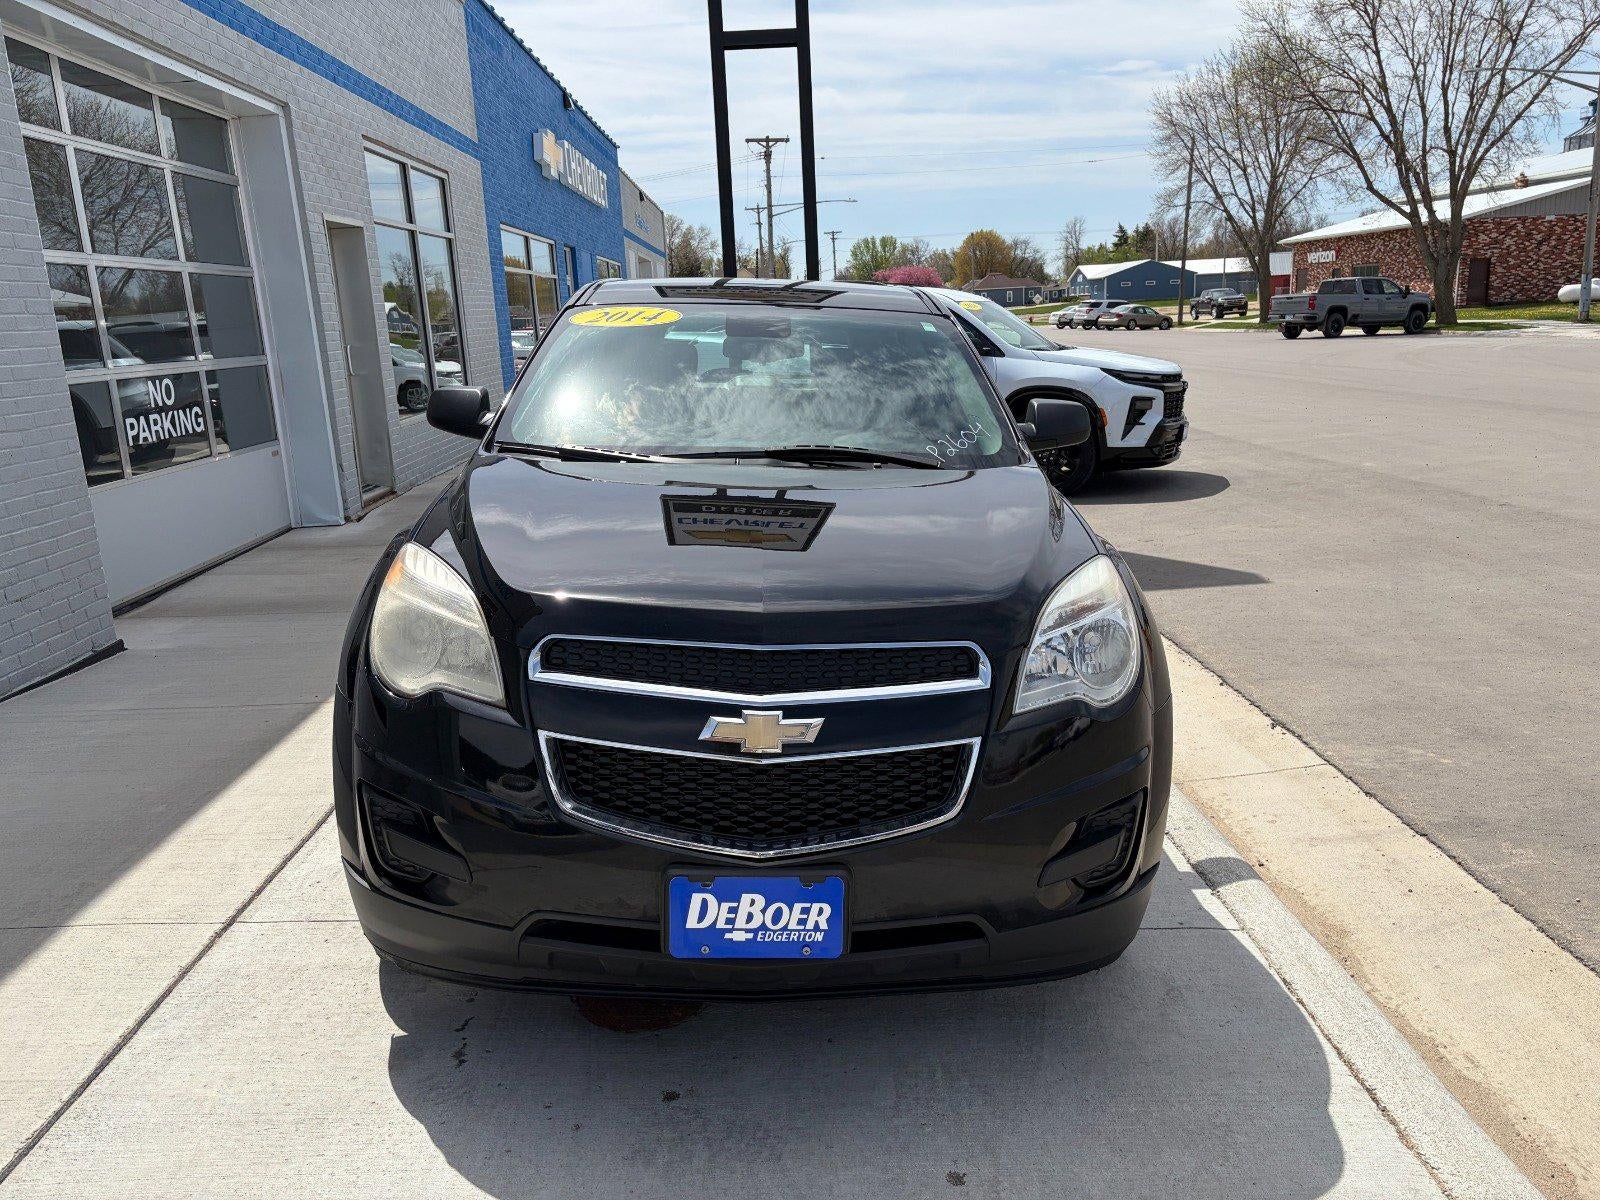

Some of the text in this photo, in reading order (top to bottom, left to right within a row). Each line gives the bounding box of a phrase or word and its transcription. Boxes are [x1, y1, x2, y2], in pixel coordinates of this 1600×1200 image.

[1307, 250, 1336, 263] verizon
[584, 309, 669, 323] 2014
[147, 378, 175, 407] NO
[125, 406, 205, 446] PARKING
[926, 422, 991, 462] P2604
[757, 930, 824, 942] EDGERTON
